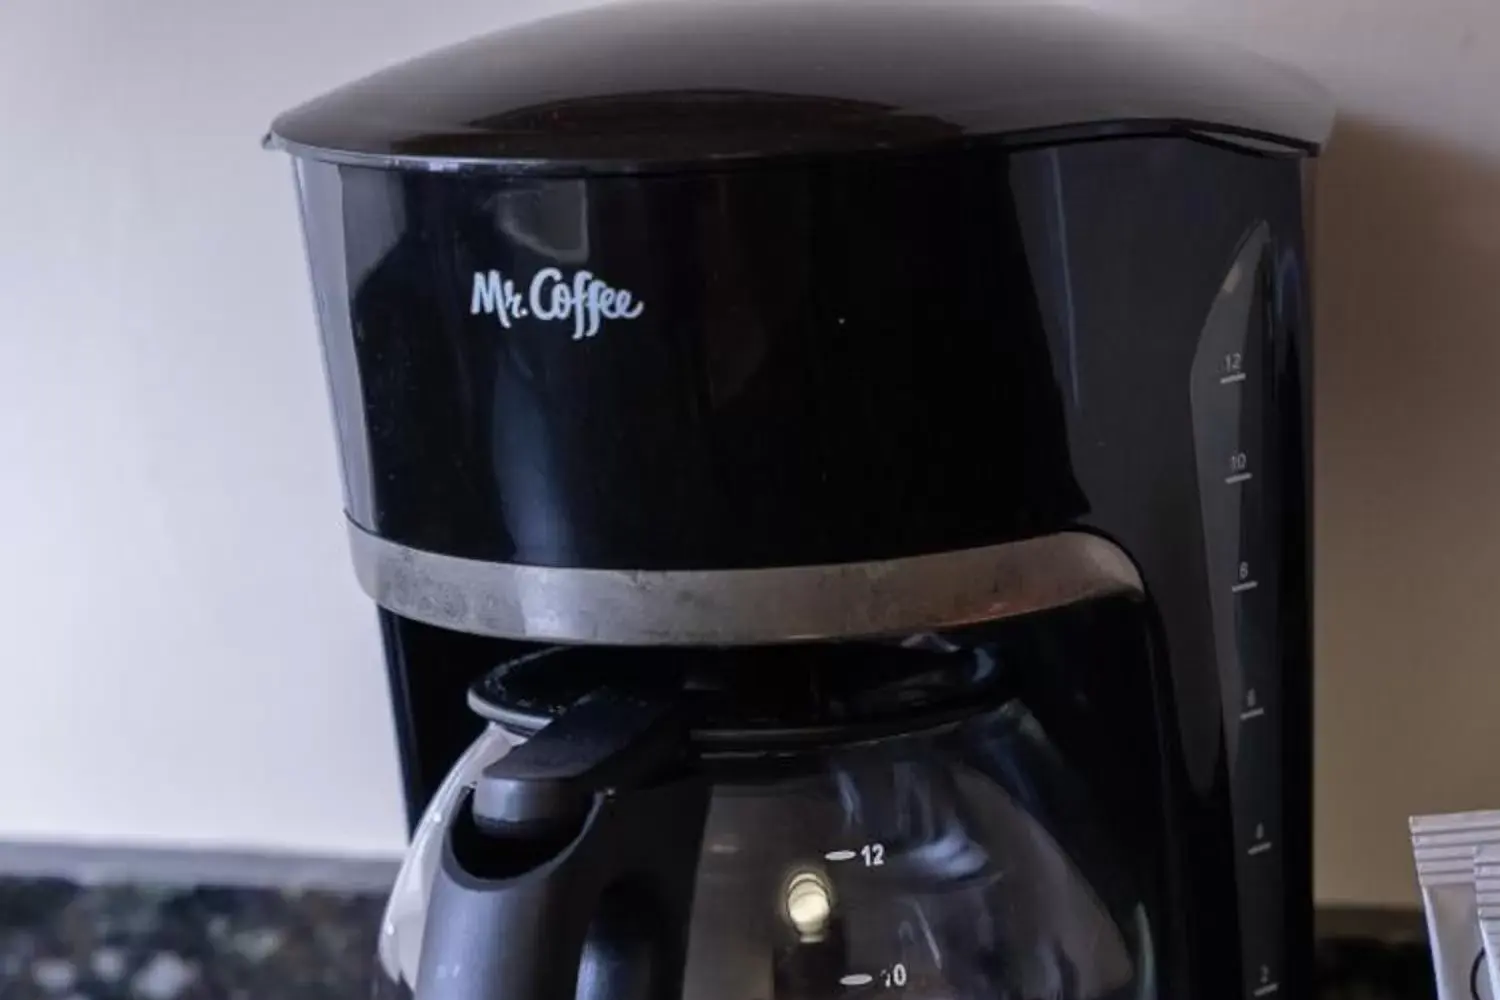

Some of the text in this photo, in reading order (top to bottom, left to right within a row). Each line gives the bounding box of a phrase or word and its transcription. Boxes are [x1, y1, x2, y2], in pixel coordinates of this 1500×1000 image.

[470, 267, 644, 340] Mr. Coffee
[1225, 353, 1242, 371] 12
[861, 844, 884, 866] 12
